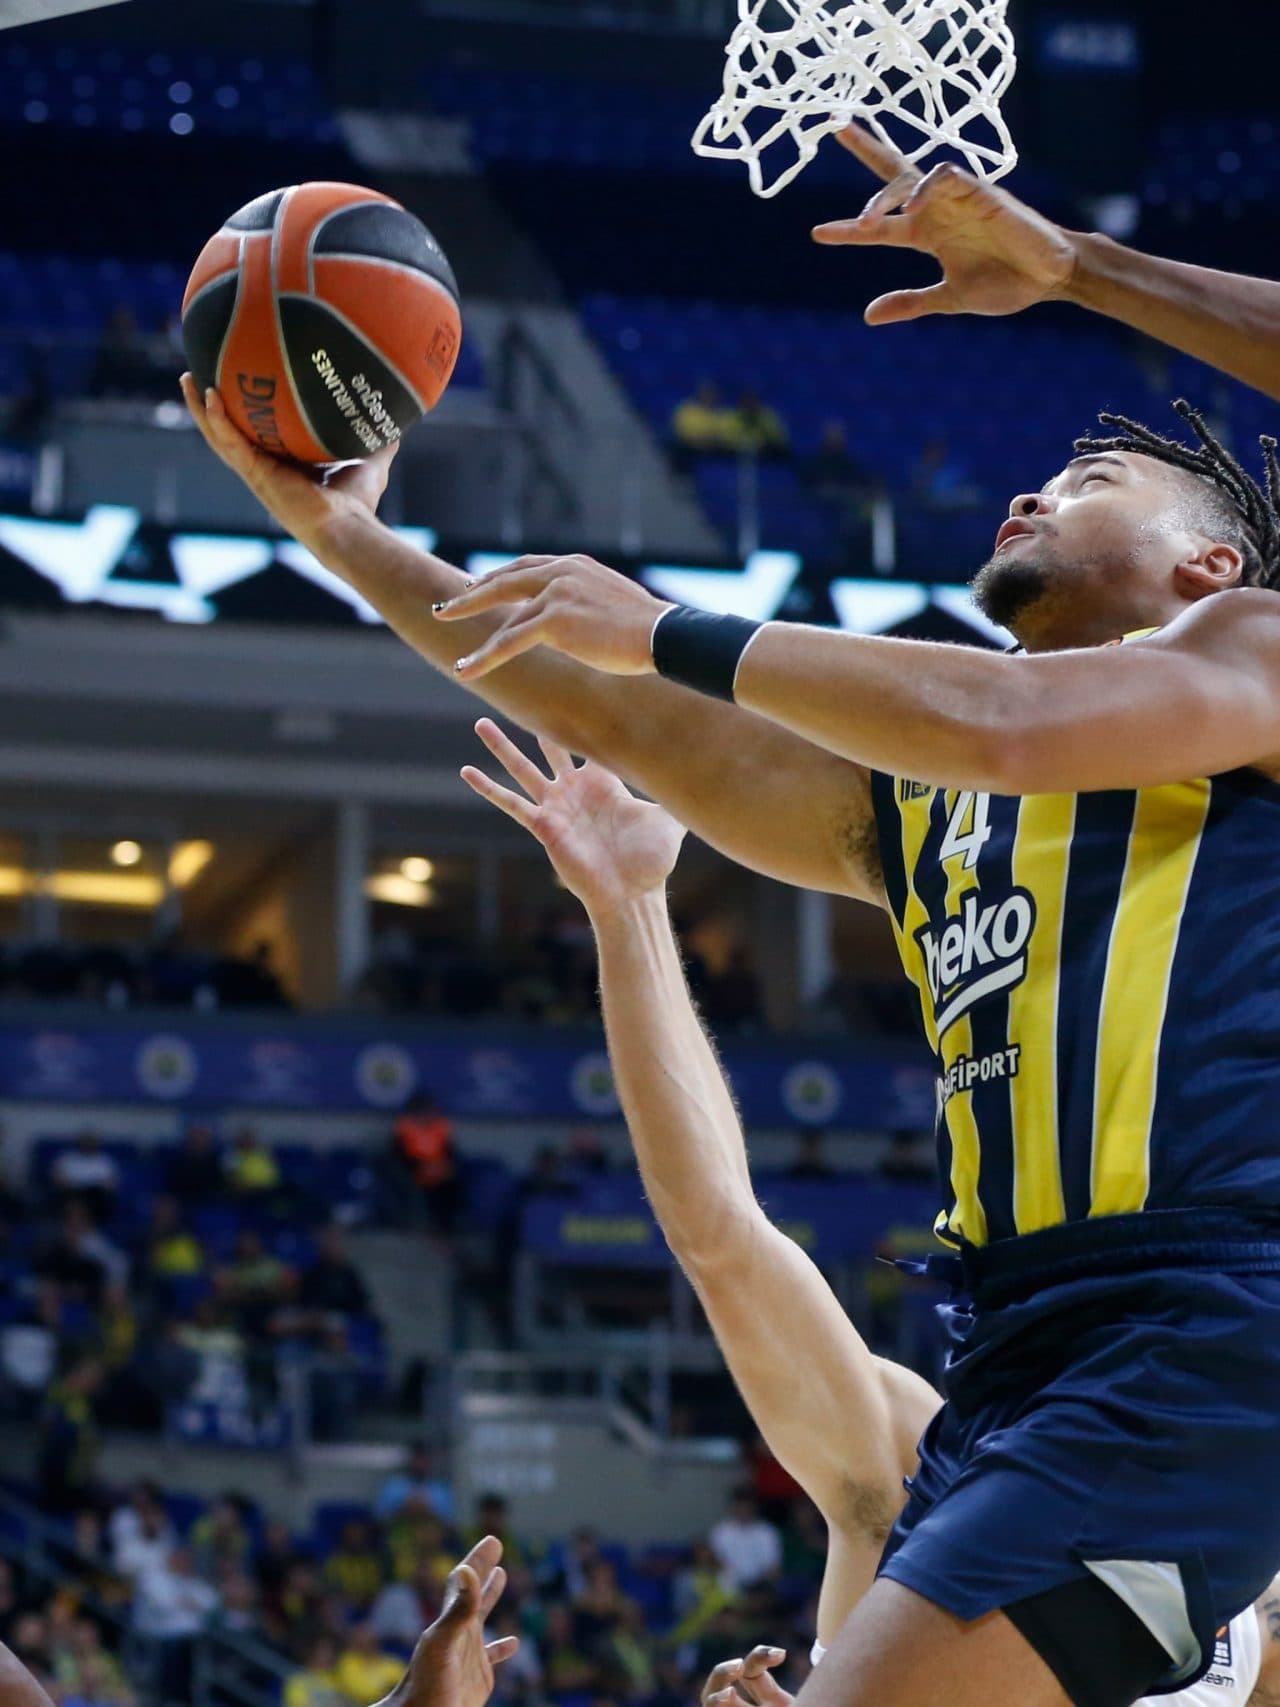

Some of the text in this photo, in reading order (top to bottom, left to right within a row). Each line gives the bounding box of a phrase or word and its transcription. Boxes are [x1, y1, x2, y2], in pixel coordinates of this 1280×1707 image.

[311, 348, 360, 418] AIRLINES
[938, 791, 992, 869] 4
[920, 894, 1032, 1003] beko
